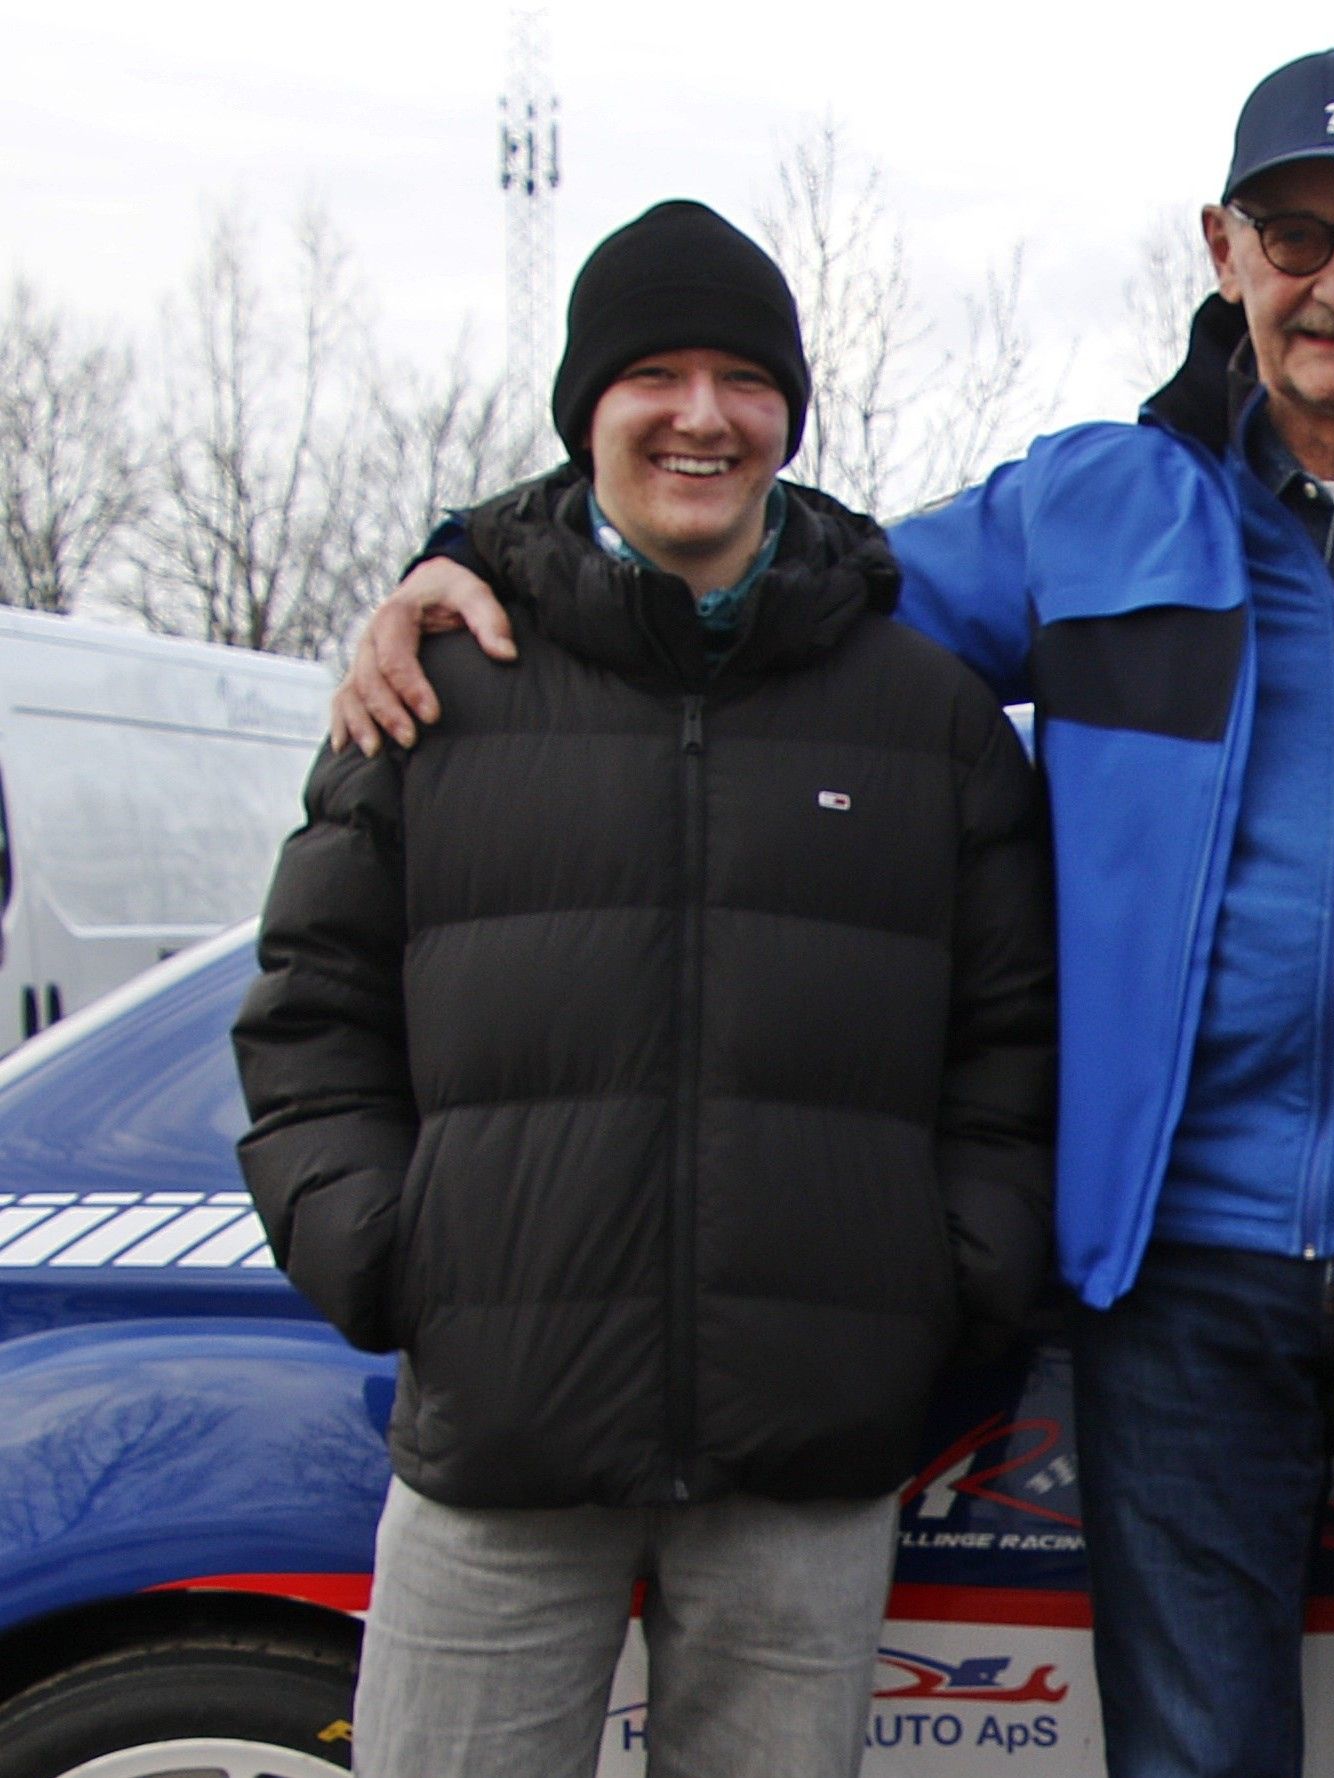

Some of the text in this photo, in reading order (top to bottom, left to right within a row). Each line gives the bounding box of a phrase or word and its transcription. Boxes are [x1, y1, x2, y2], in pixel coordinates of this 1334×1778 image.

[1001, 1533, 1086, 1550] RACIN
[865, 1714, 963, 1747] UTO
[976, 1714, 1058, 1754] ApS
